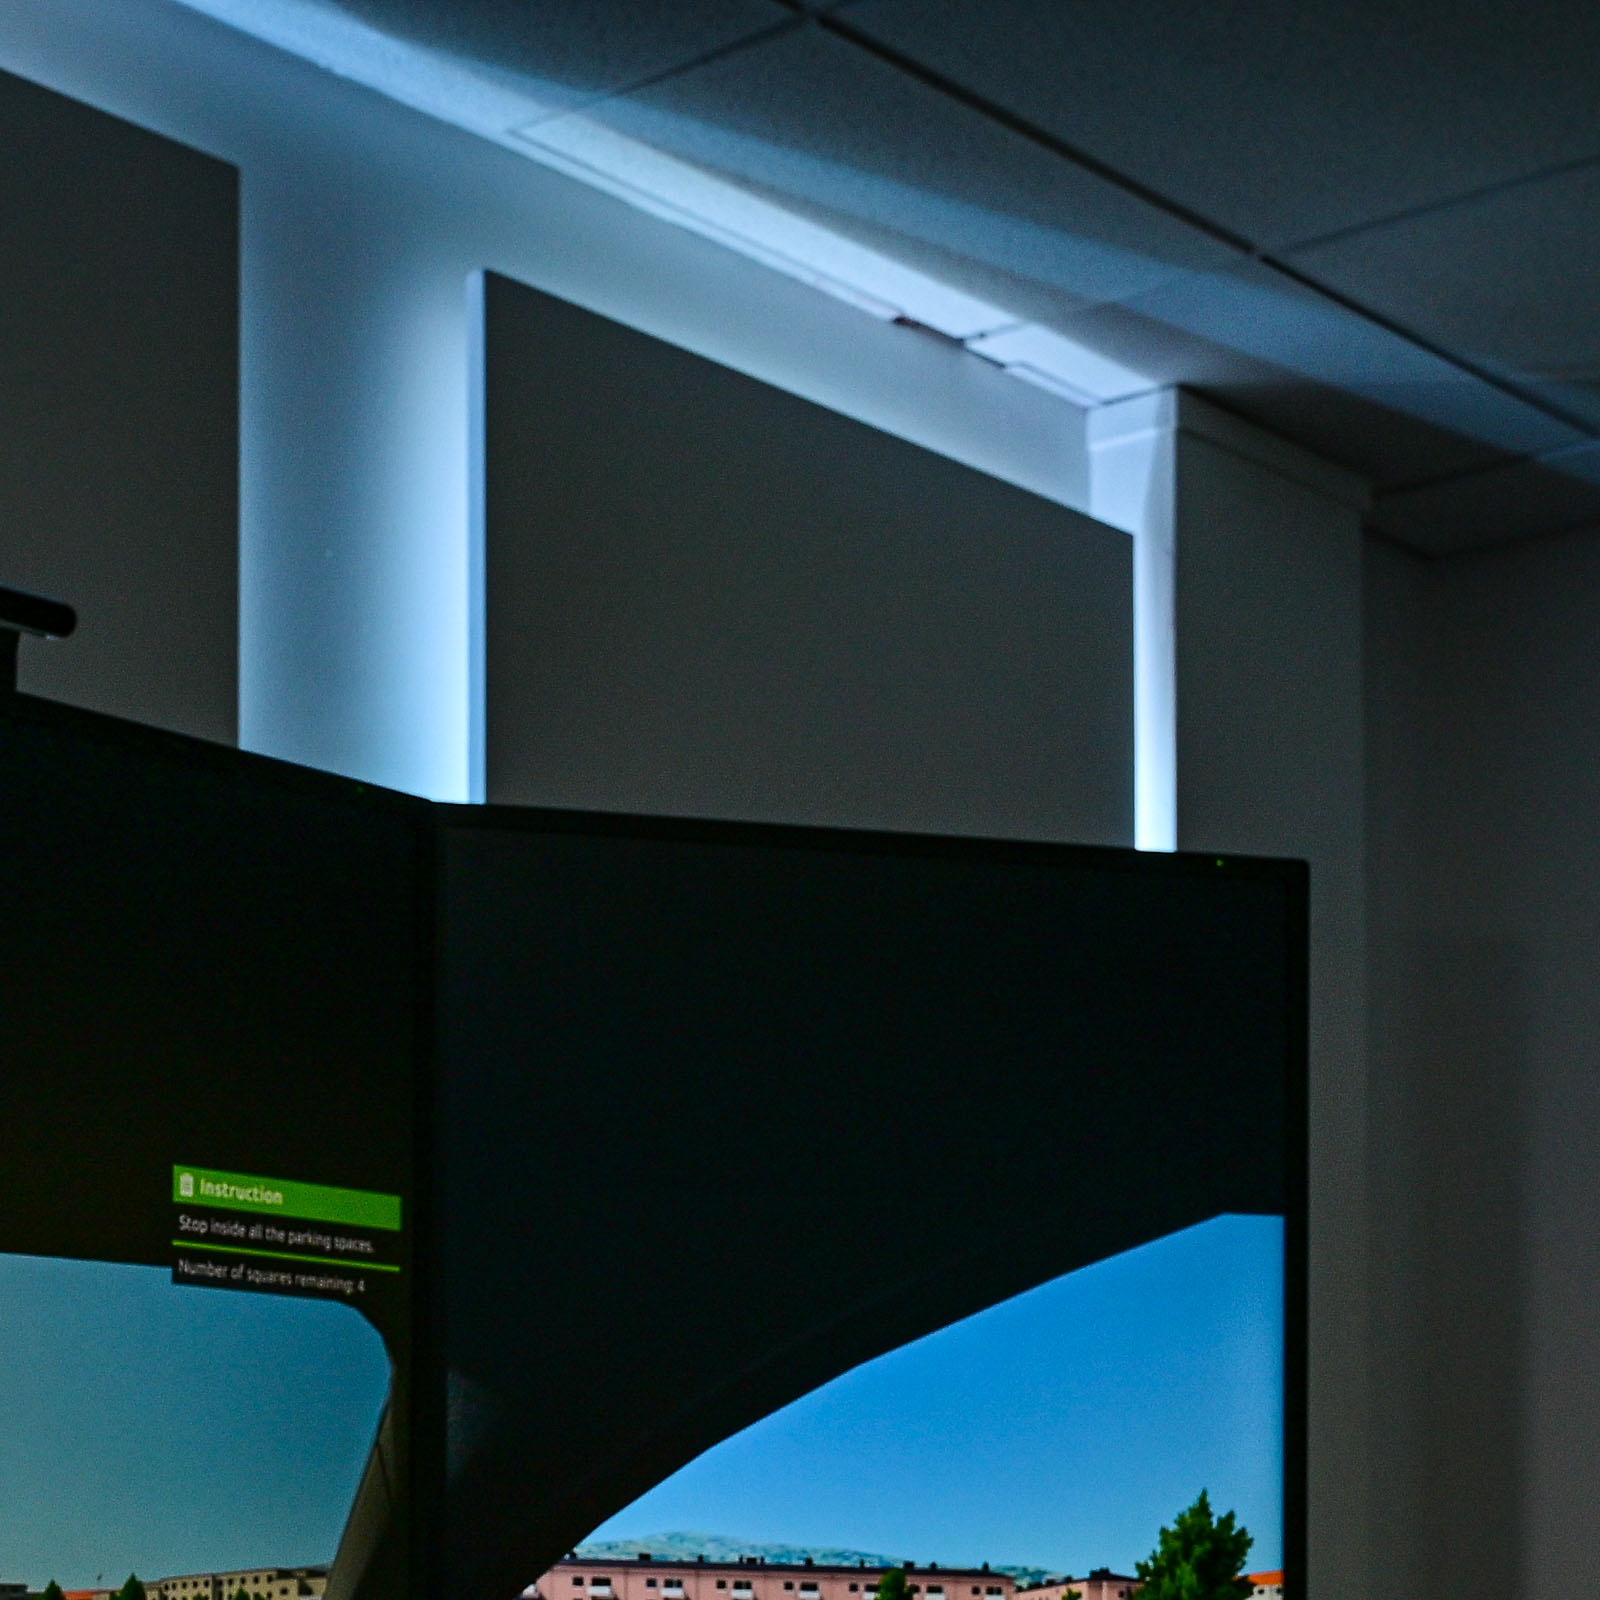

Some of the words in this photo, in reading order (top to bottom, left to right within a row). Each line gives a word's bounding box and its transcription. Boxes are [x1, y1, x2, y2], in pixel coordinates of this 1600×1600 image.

[200, 1177, 284, 1205] Instruction
[179, 1214, 209, 1234] Stop
[248, 1221, 263, 1240] all
[264, 1225, 286, 1243] the
[287, 1228, 332, 1252] parking
[178, 1257, 228, 1279] Number
[230, 1263, 245, 1280] of
[246, 1267, 293, 1287] squares
